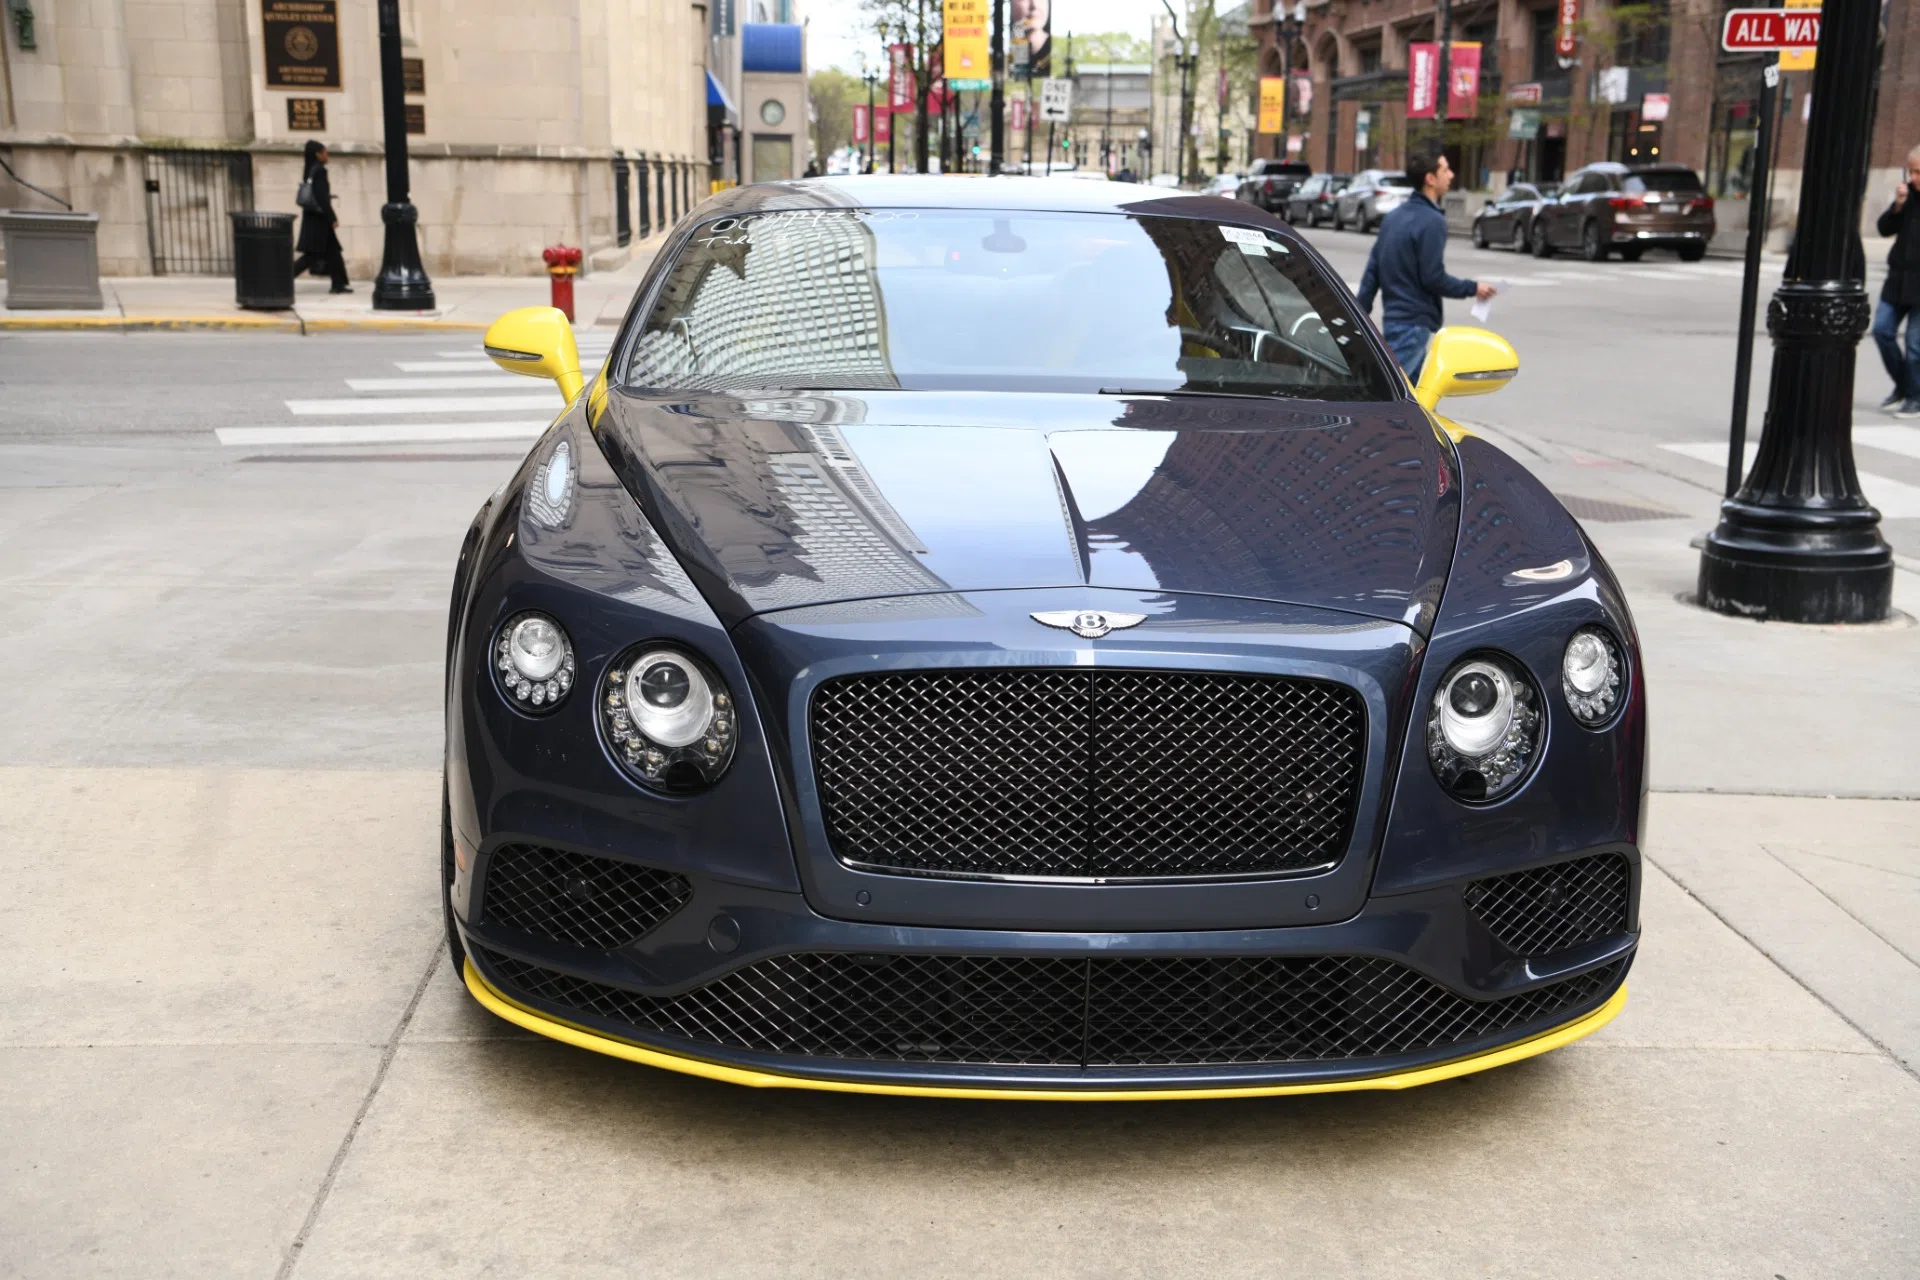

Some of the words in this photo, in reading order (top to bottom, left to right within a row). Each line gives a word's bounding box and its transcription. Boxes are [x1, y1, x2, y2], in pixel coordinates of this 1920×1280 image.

[1735, 18, 1775, 42] ALL
[1785, 18, 1820, 42] WAY
[1046, 82, 1067, 93] ONE
[1045, 94, 1067, 104] WAY
